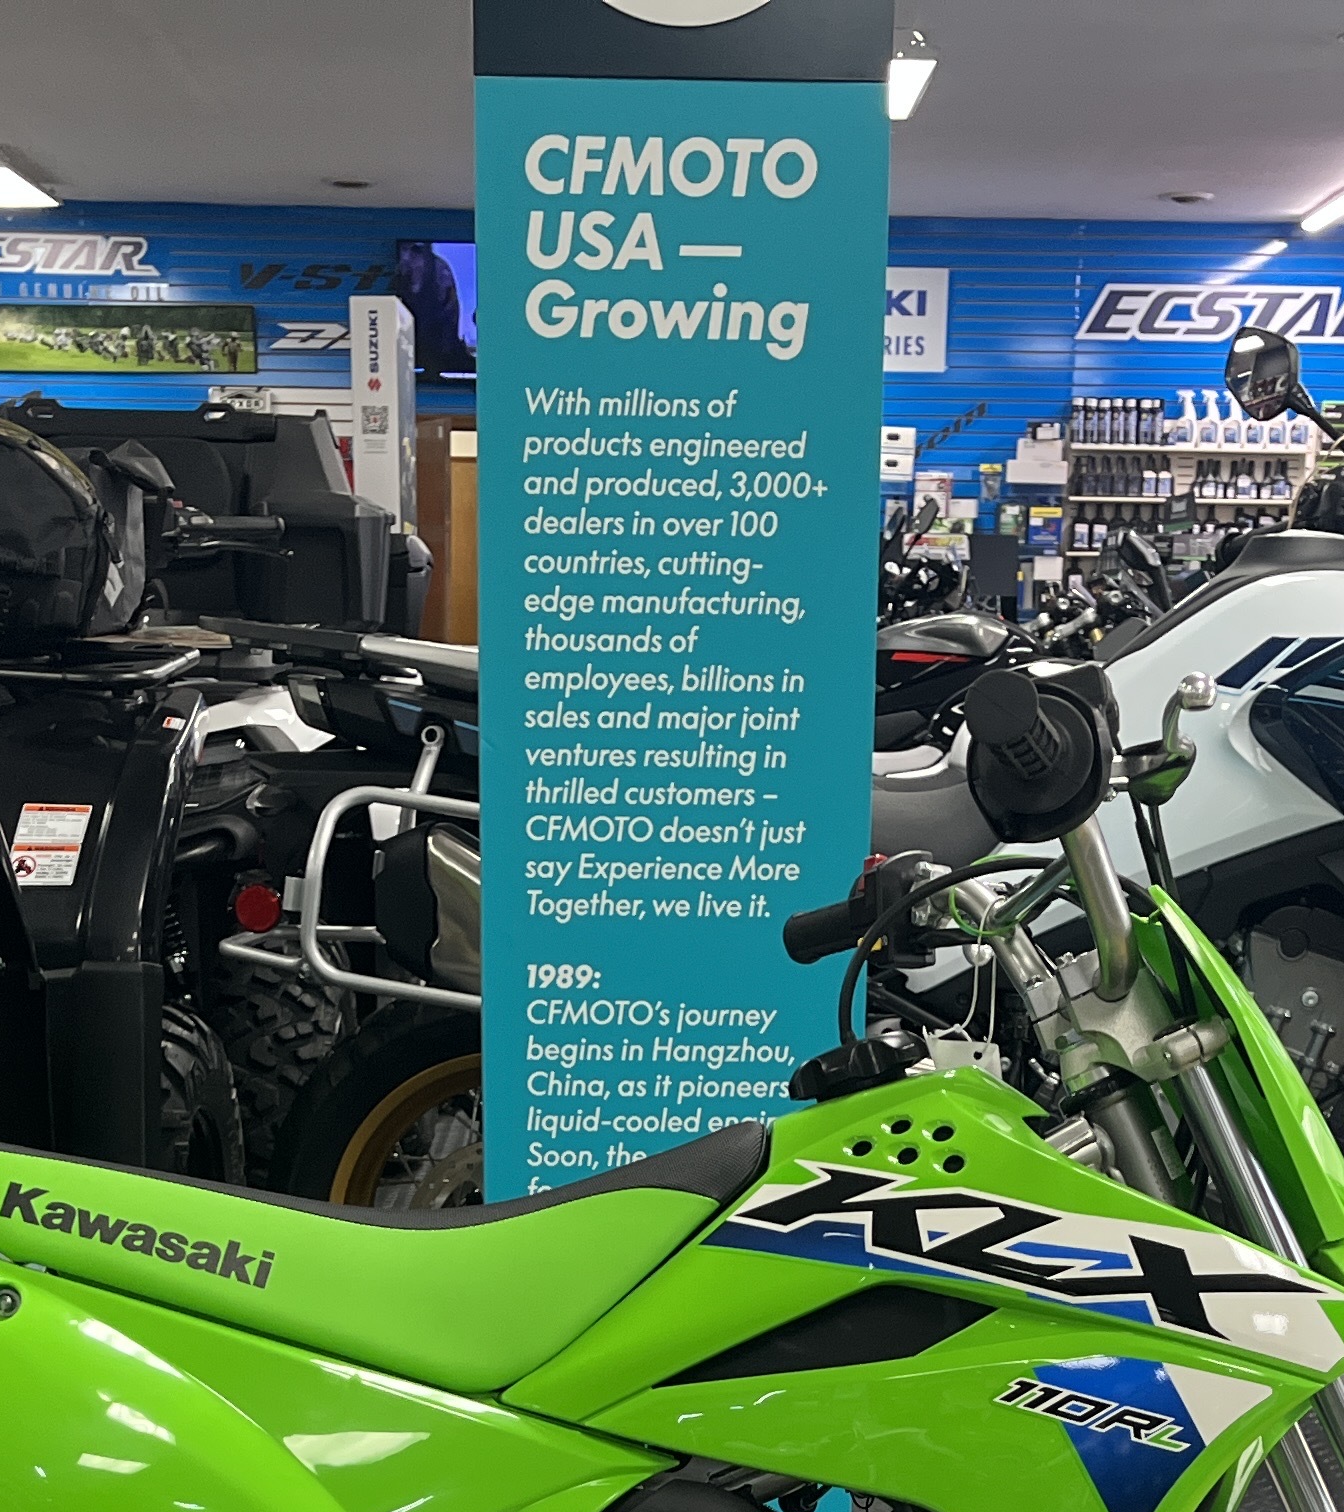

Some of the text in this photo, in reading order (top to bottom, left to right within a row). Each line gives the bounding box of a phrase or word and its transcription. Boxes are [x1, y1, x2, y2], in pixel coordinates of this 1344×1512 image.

[525, 134, 818, 199] CFMOTO
[526, 210, 664, 270] USA
[525, 279, 809, 361] Growing
[368, 309, 379, 374] SUZUKI
[524, 387, 739, 418] With millions of
[522, 427, 807, 466] products engineered
[523, 467, 828, 504] and produced, 3,000+
[523, 506, 779, 538] dealers in over 100
[524, 548, 764, 585] countries, cutting-
[524, 584, 806, 625] edge manufacturing,
[524, 623, 700, 653] thousands of
[524, 662, 805, 699] employees, billions in
[524, 700, 801, 739] sales and major joint
[525, 740, 787, 777] ventures resulting in
[525, 776, 619, 805] thrilled
[624, 781, 755, 807] customers
[525, 814, 654, 843] CFMOTO
[759, 819, 807, 851] just
[525, 853, 801, 887] say Experience More
[526, 889, 771, 924] Together, we live it.
[527, 963, 602, 989] 1989:
[676, 1002, 778, 1034] journey
[526, 1034, 795, 1070] begins in Hangzhou,
[527, 1070, 790, 1105] China, as it pioneers
[527, 1106, 702, 1139] liquid-cooled
[526, 1141, 599, 1171] Soon,
[0, 1181, 276, 1289] Kawasaki
